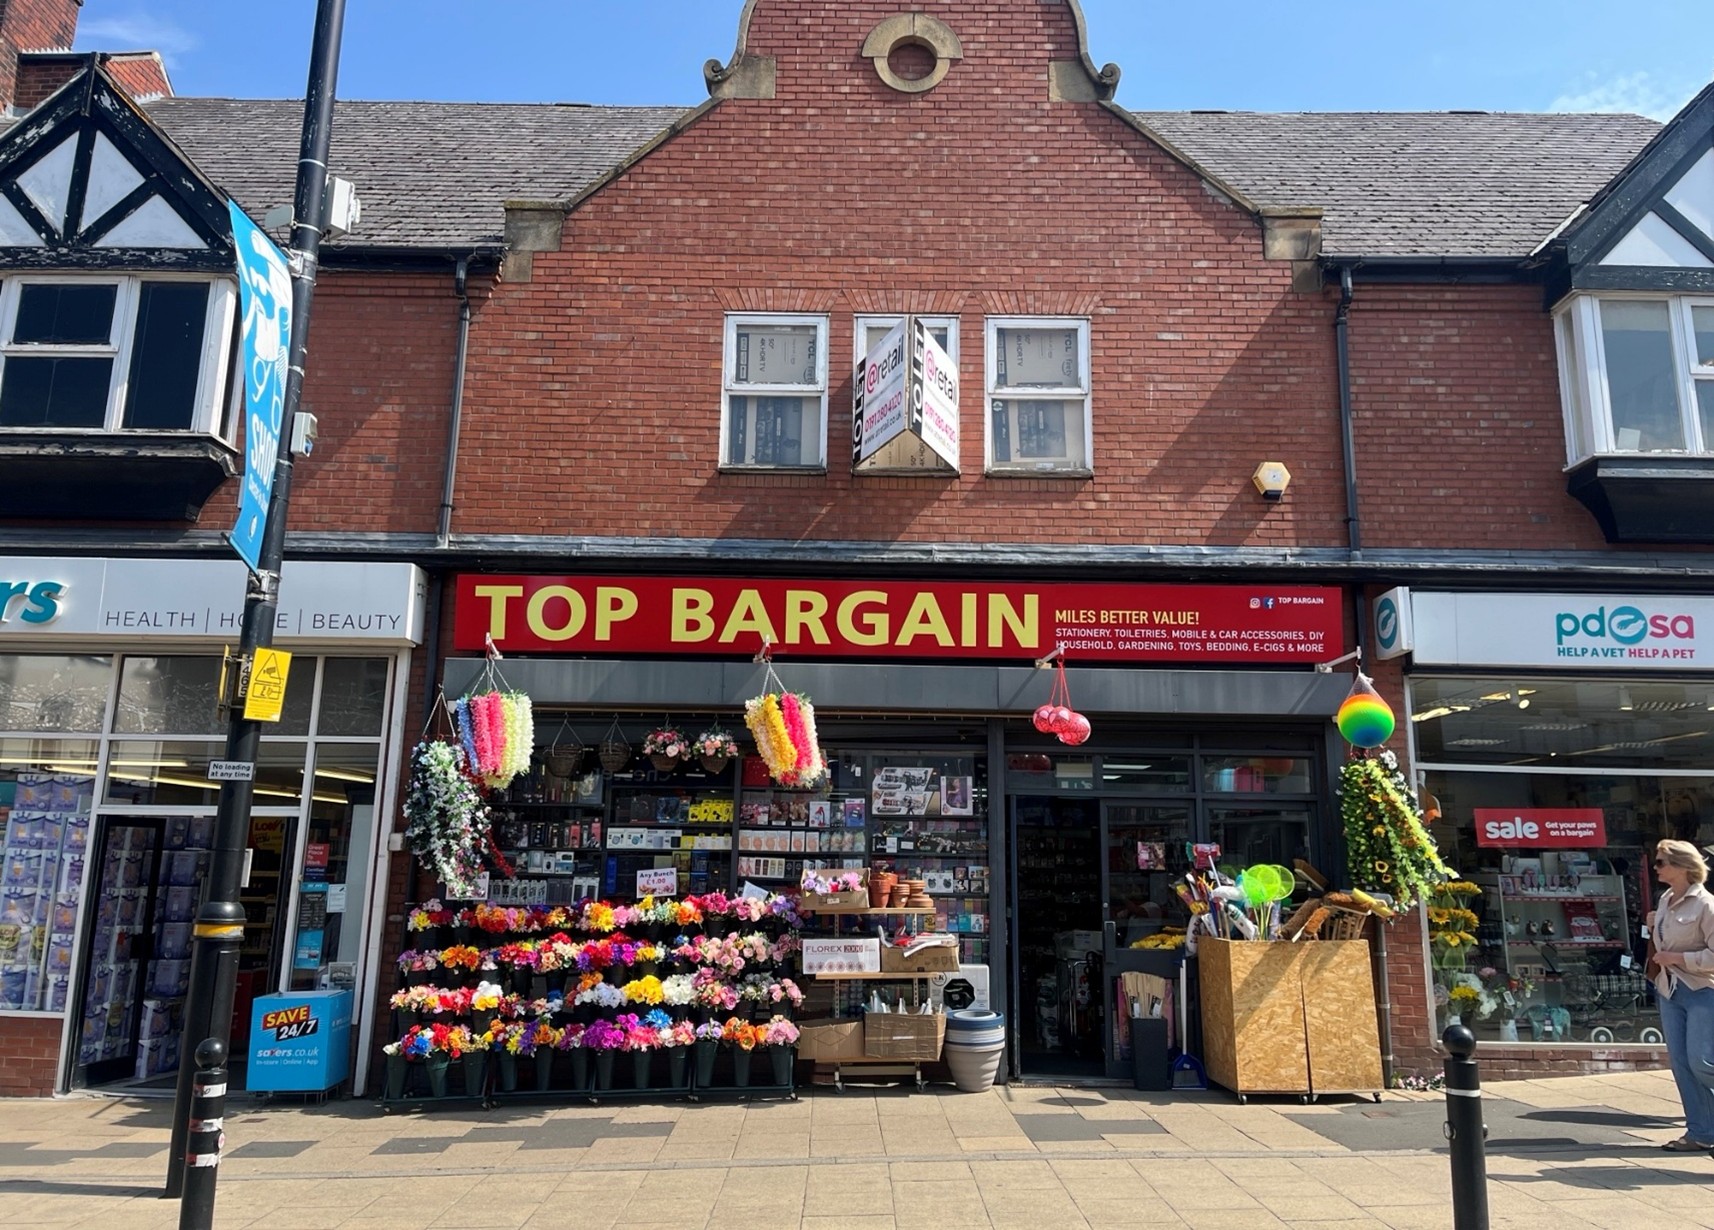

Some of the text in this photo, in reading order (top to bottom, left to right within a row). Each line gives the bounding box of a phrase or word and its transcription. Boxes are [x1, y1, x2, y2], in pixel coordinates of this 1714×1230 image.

[913, 324, 924, 424] TO LET
[853, 370, 865, 455] TO LET
[251, 413, 277, 491] SHOP
[106, 611, 402, 630] HEALTH HE BEAUTY
[475, 585, 1040, 649] TOP BARGAIN
[1055, 610, 1199, 625] MILES BETTER VALUE!
[1172, 630, 1208, 639] MOBILE
[1209, 630, 1217, 639] &
[1219, 631, 1238, 639] CAR
[1309, 631, 1325, 640] DIY
[1253, 643, 1285, 652] E-CIGS
[1287, 643, 1295, 652] &
[1297, 643, 1324, 652] MORE
[1557, 647, 1695, 659] HELP A VET HELP A PET
[225, 763, 251, 772] loading
[1485, 817, 1539, 839] sale
[1559, 822, 1576, 831] your
[1577, 822, 1597, 830] paws
[1566, 829, 1594, 838] bargain
[266, 1006, 309, 1028] SAVE
[279, 1019, 318, 1040] 24/7
[256, 1047, 319, 1058] savers.co.uk
[306, 1059, 319, 1067] App
